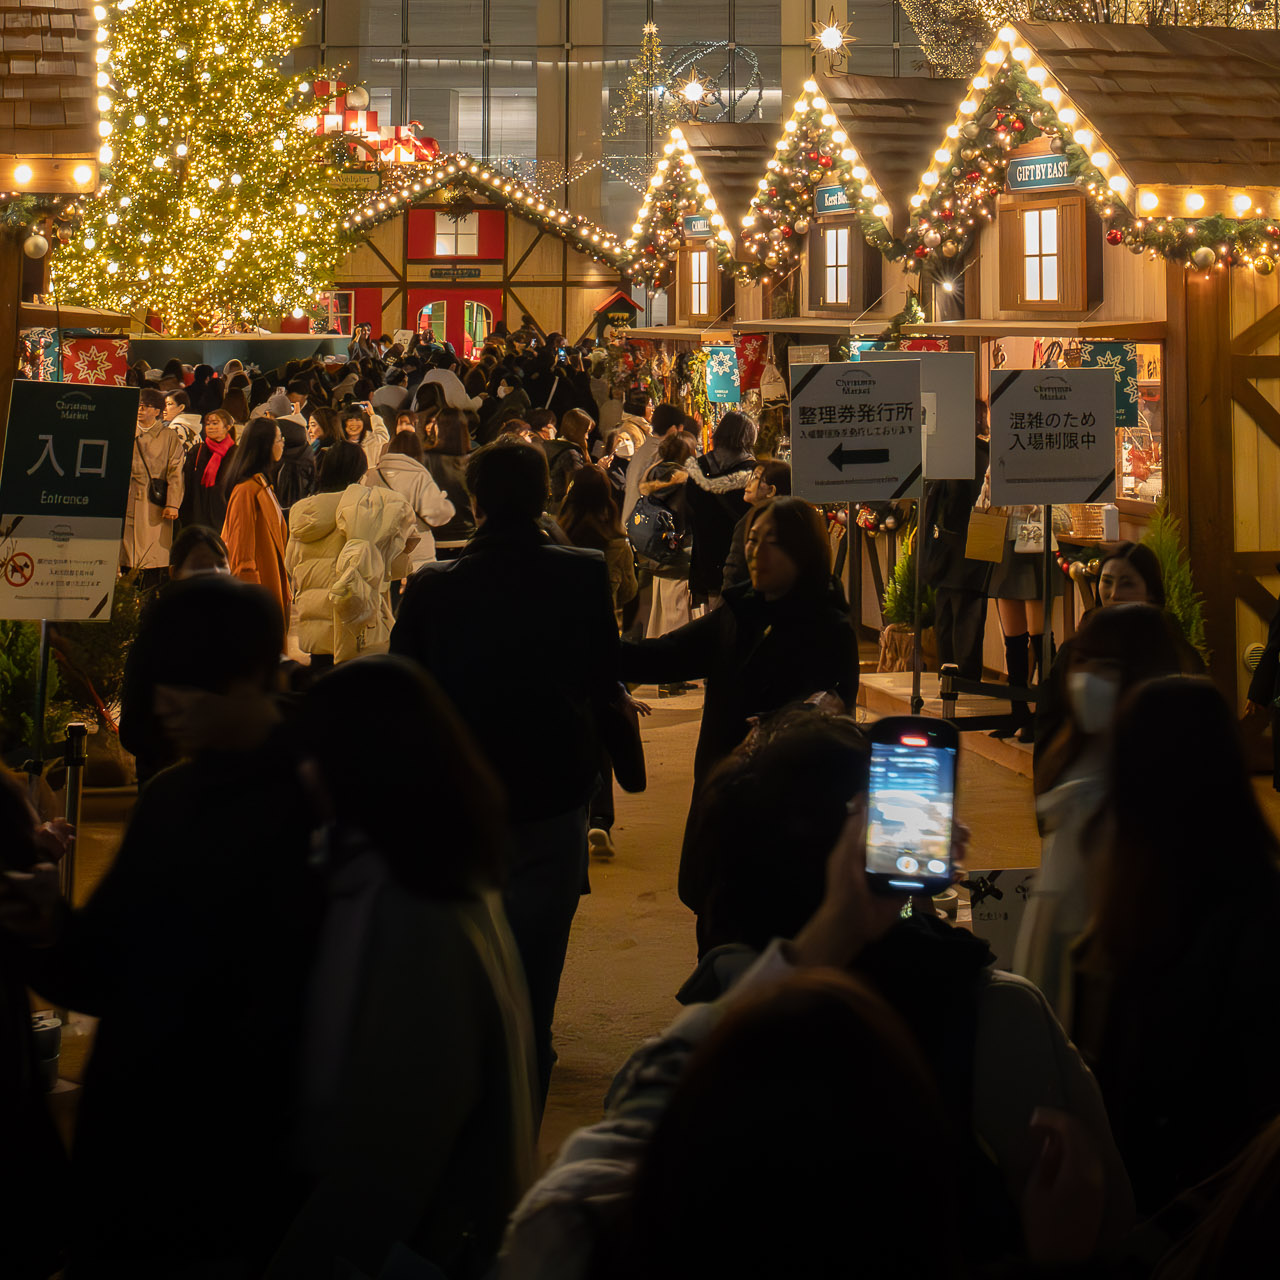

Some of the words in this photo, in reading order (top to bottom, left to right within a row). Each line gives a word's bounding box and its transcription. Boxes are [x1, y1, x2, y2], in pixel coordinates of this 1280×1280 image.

[1016, 164, 1035, 182] GIFT
[1035, 163, 1047, 180] BY
[1047, 161, 1069, 179] EAST
[824, 193, 838, 207] Kerst
[798, 402, 914, 425] 整理券発行所
[1009, 411, 1096, 429] 混雑のため
[1009, 431, 1096, 451] 入場制限中
[26, 434, 109, 478] 入口
[40, 490, 89, 505] Entrance
